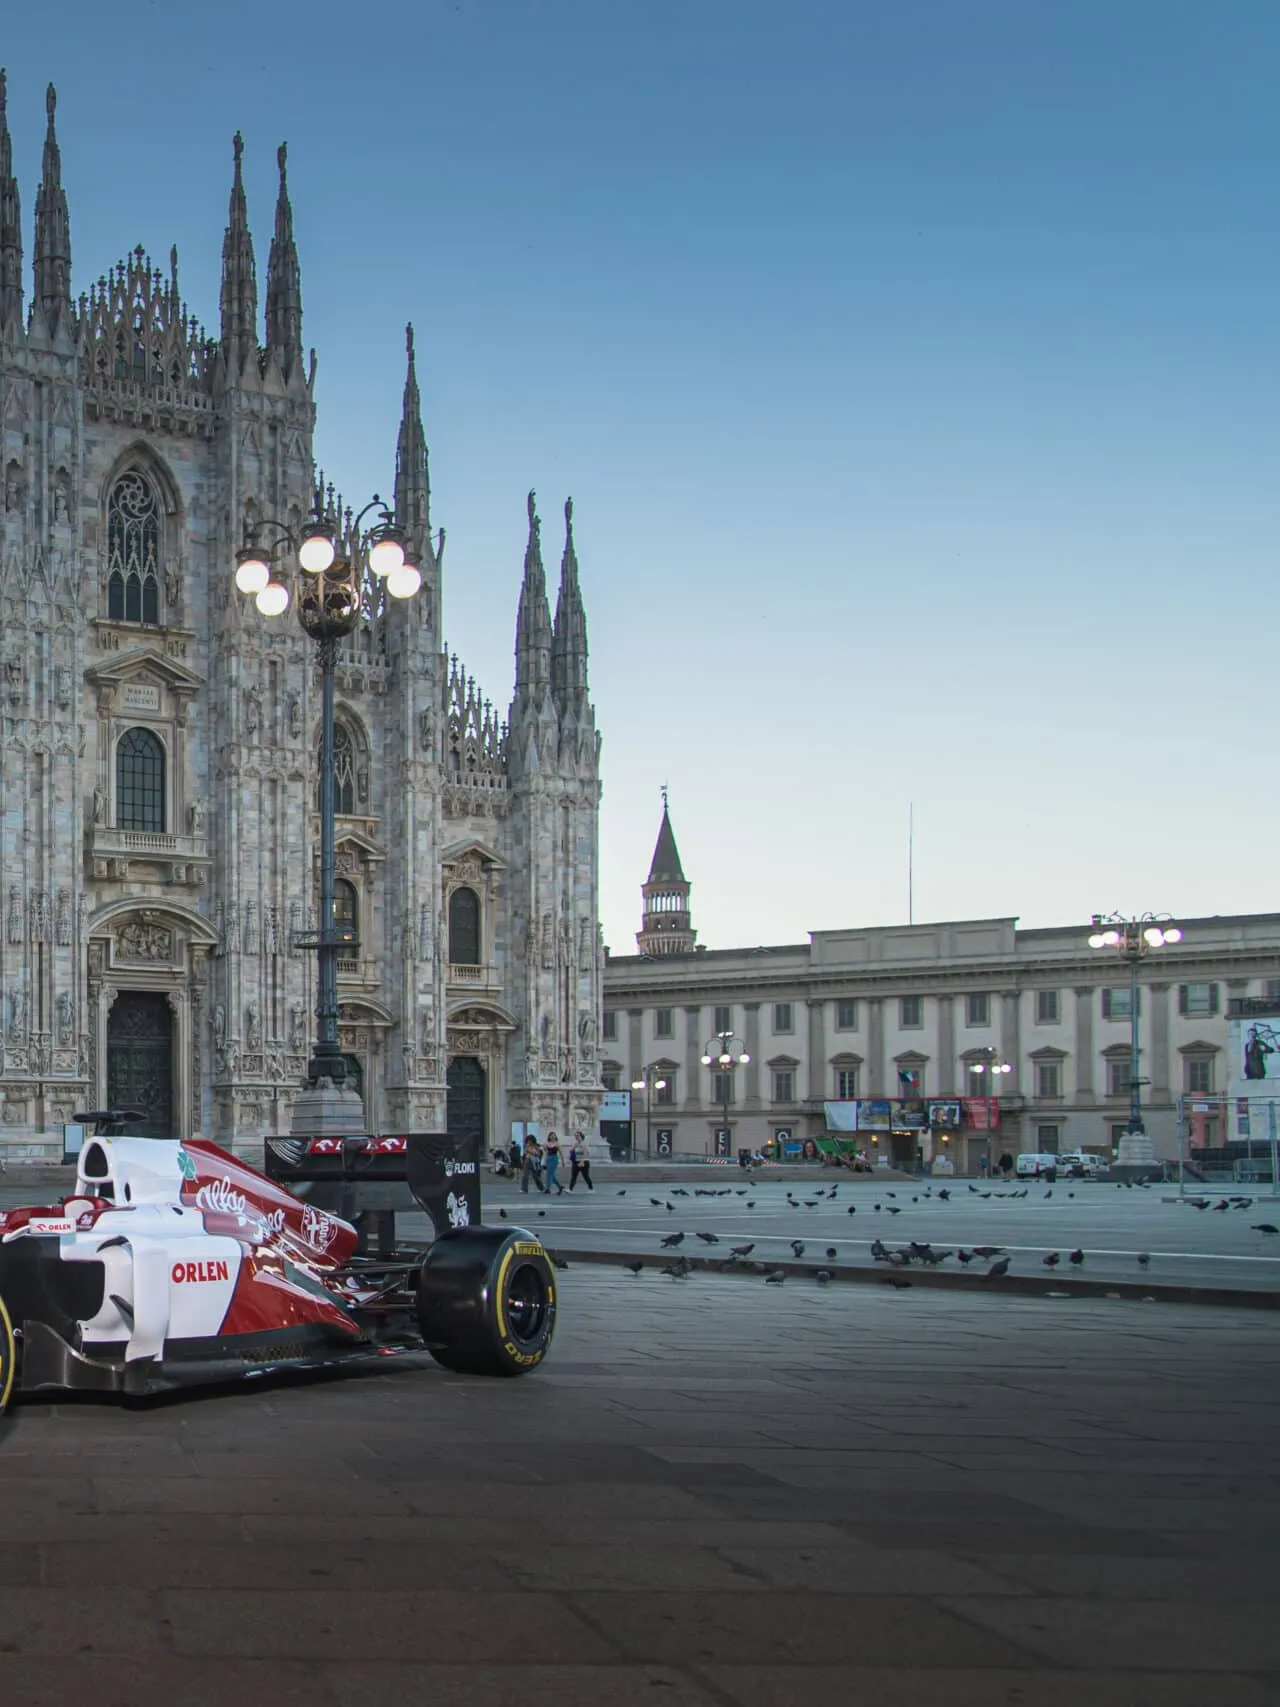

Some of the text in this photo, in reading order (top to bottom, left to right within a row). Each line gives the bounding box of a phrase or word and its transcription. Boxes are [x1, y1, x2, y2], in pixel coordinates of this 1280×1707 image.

[454, 1161, 475, 1175] FLOKI
[47, 1223, 72, 1231] ORLEN
[513, 1240, 544, 1256] PIRELLI
[171, 1260, 229, 1284] ORLEN
